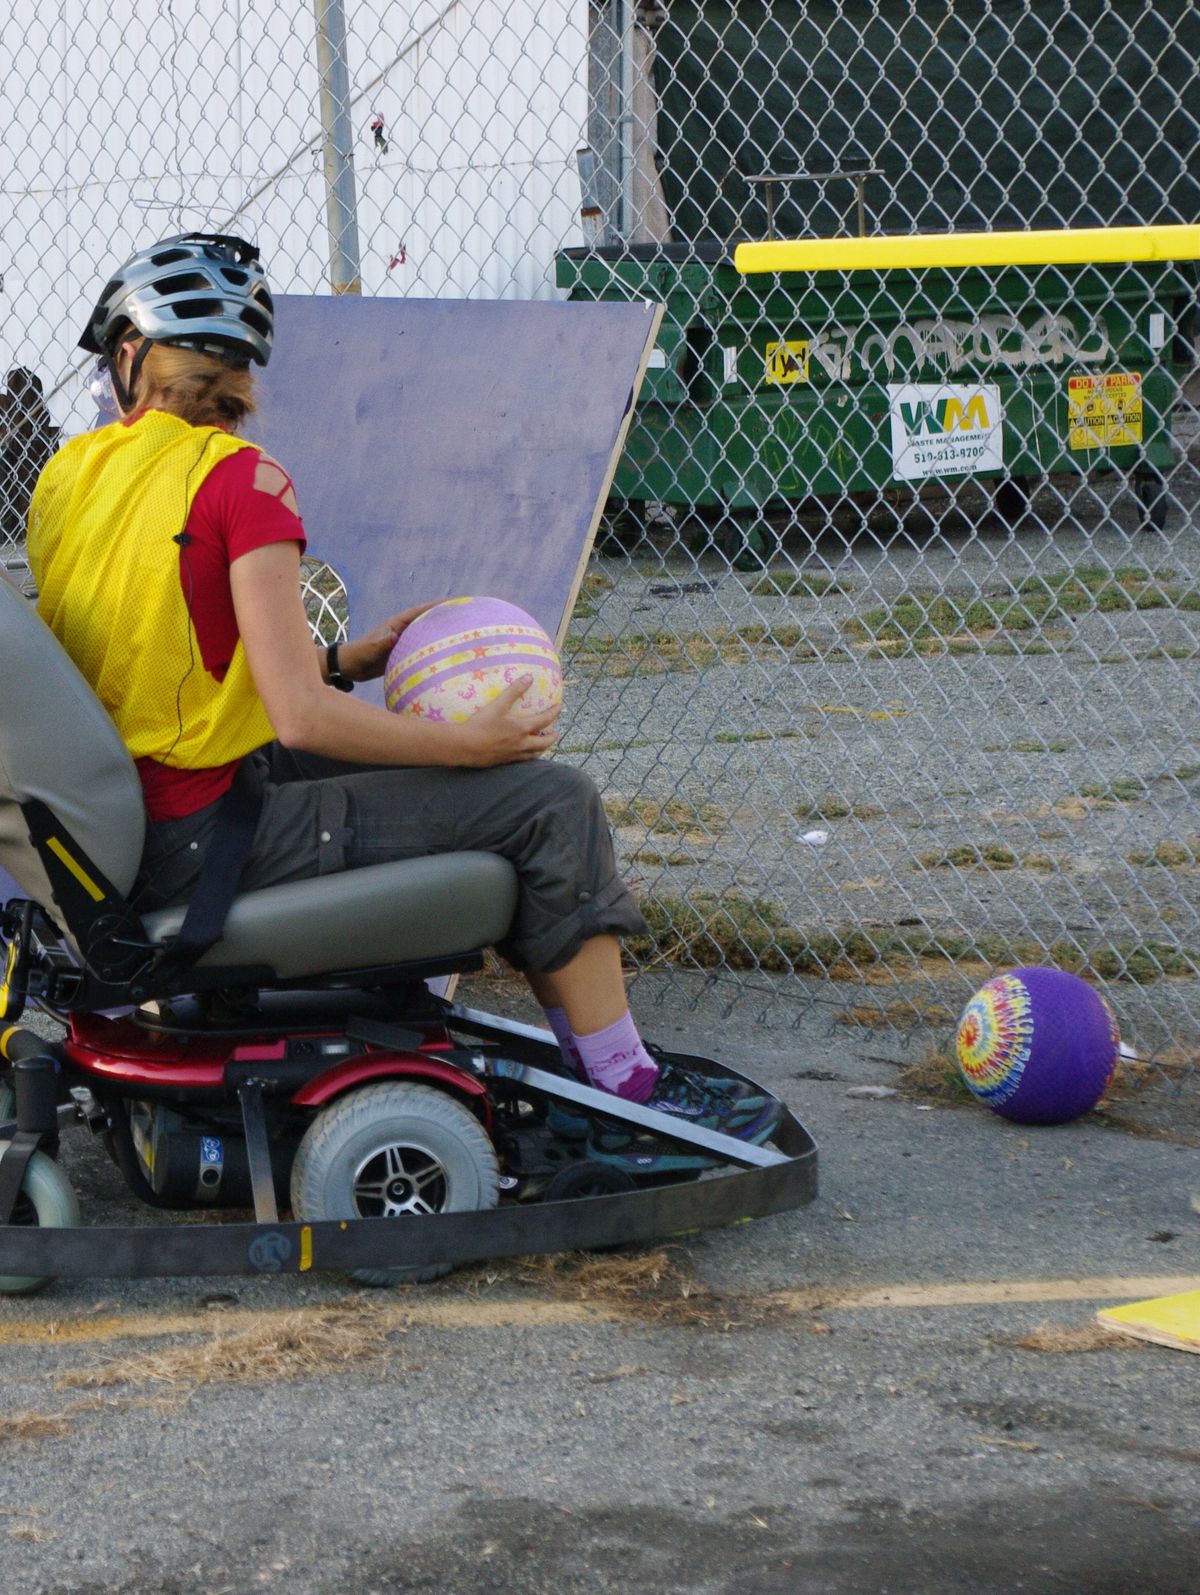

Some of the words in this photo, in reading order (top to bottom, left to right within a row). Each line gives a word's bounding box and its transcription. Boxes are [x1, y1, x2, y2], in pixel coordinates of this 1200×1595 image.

[1076, 379, 1088, 389] DO
[1091, 377, 1107, 388] NT
[1111, 376, 1134, 386] PARK
[900, 395, 990, 436] WM
[1077, 417, 1104, 425] CUTION
[1113, 414, 1140, 423] CUTION
